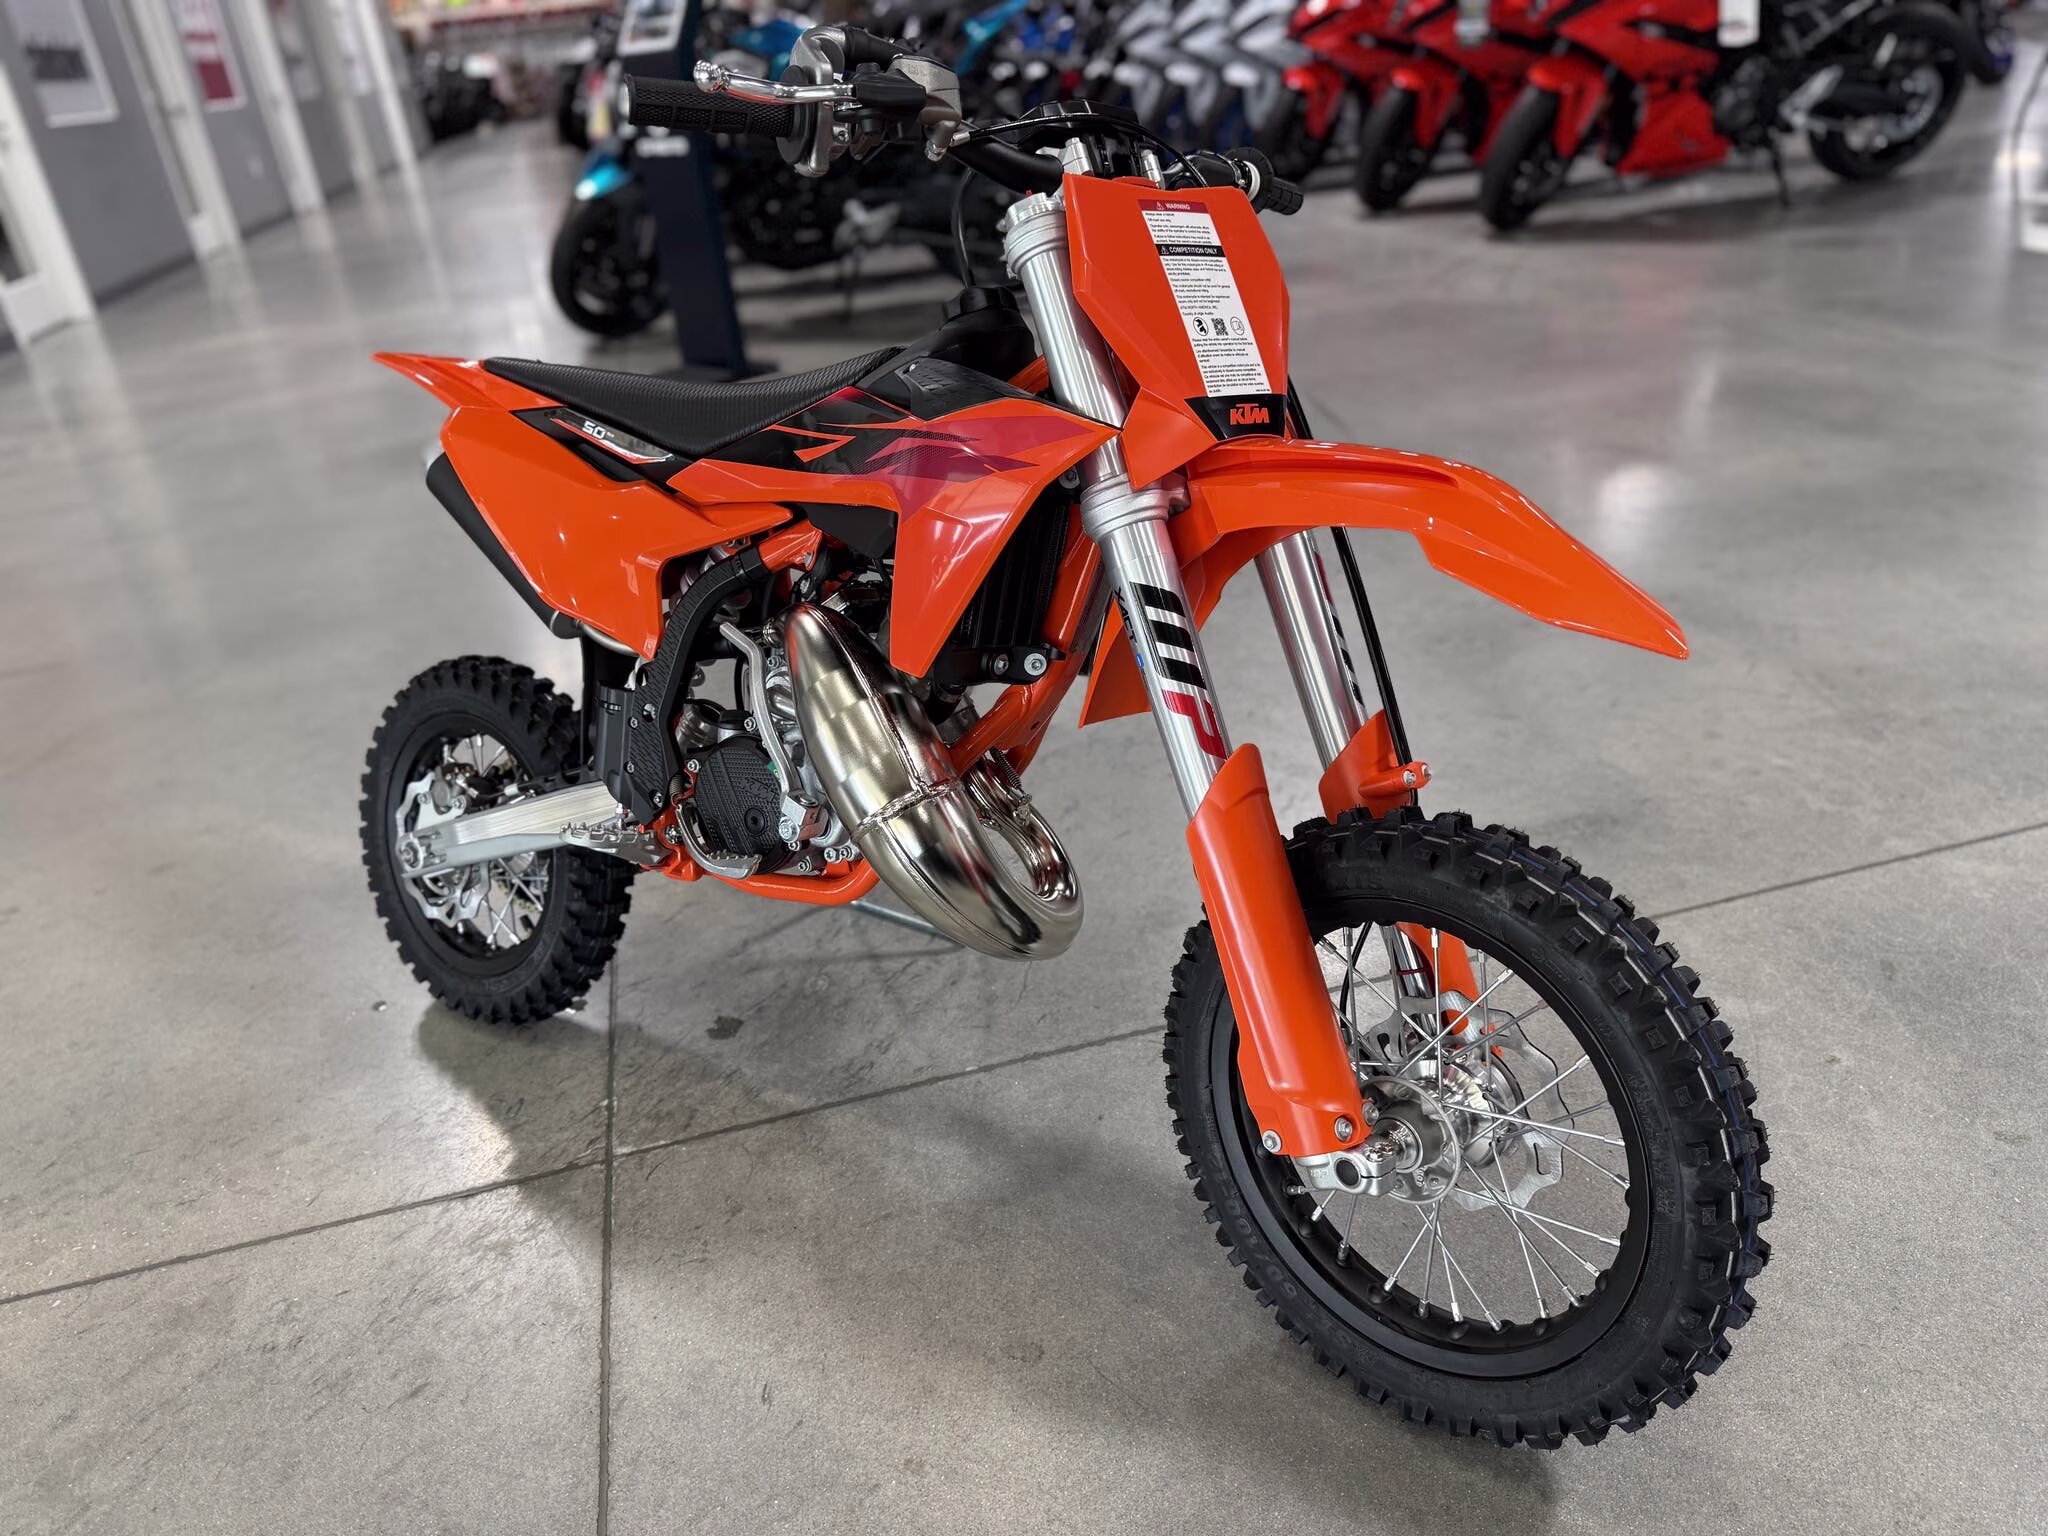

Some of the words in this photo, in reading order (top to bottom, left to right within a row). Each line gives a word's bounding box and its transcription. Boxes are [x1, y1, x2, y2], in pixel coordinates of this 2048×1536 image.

[1205, 247, 1218, 255] ONLY
[1229, 403, 1270, 426] KTM
[582, 420, 607, 440] 50
[1113, 586, 1138, 644] XACT
